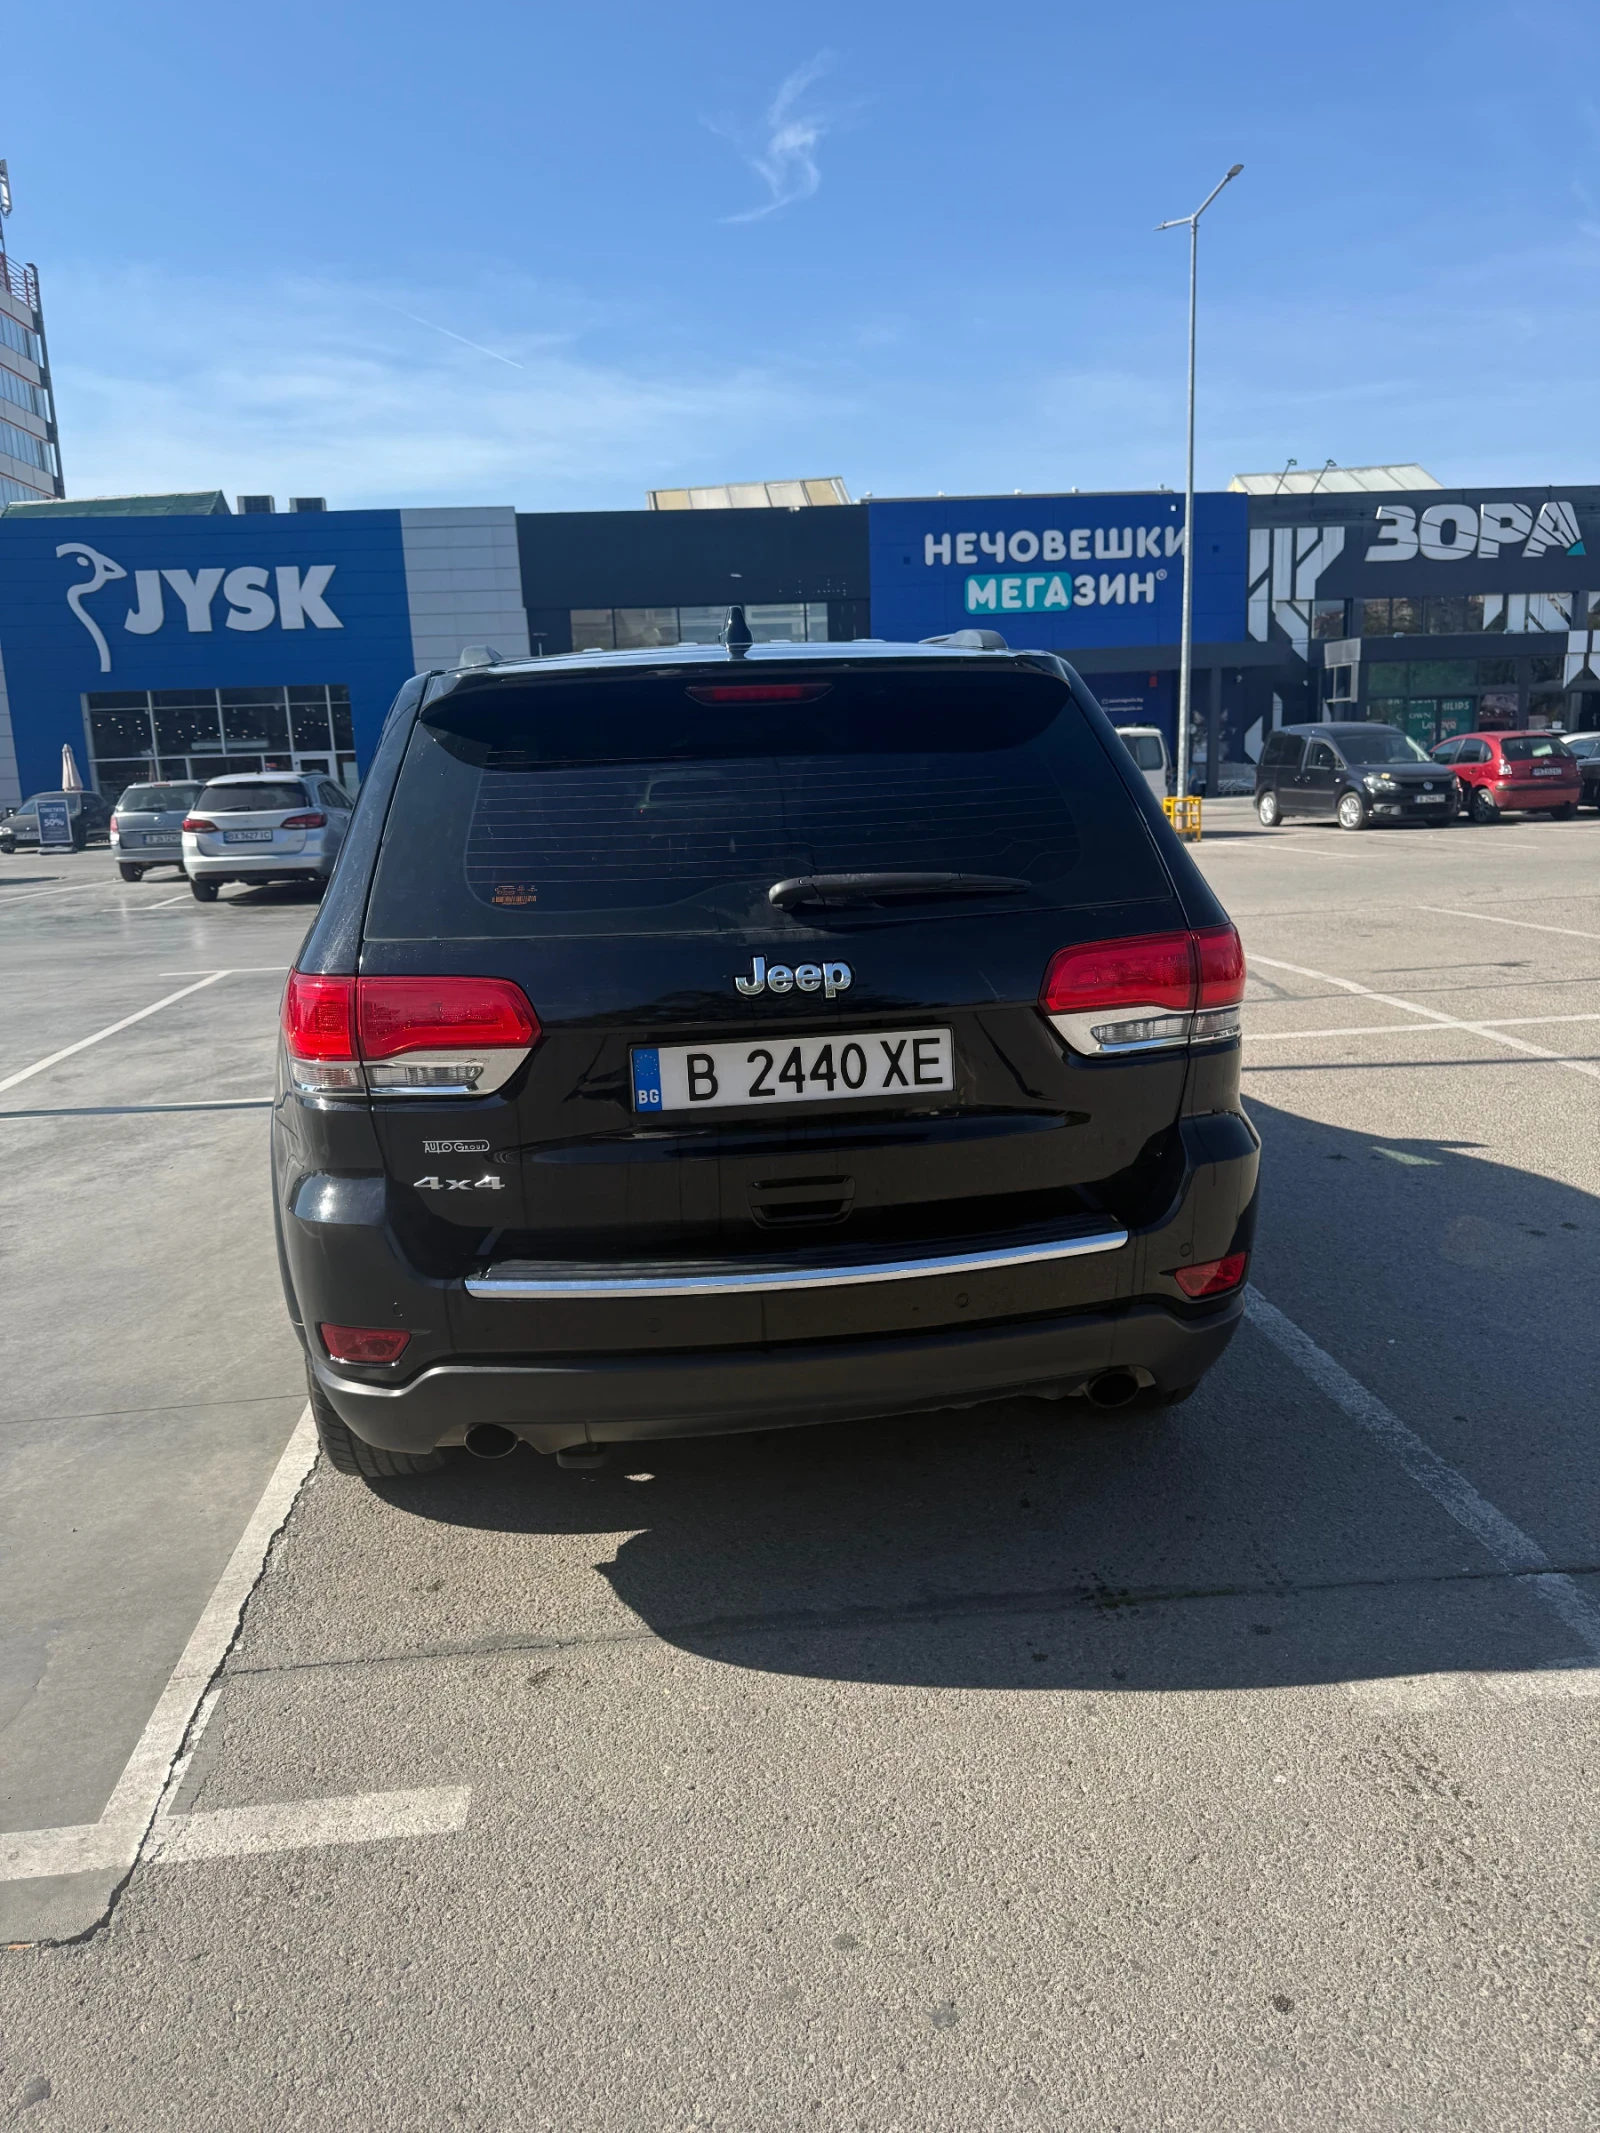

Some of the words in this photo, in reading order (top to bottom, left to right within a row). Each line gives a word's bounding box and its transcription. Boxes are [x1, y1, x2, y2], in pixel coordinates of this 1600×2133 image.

[924, 526, 1185, 566] НЕЧОВЕШКИ
[1364, 501, 1587, 562] ЗОРА
[124, 565, 345, 635] JYSK
[735, 956, 852, 998] Jeep
[638, 1089, 660, 1104] BG
[686, 1053, 719, 1101] B
[747, 1042, 867, 1098] 2440
[880, 1037, 943, 1087] XE
[413, 1175, 506, 1190] 4x4
